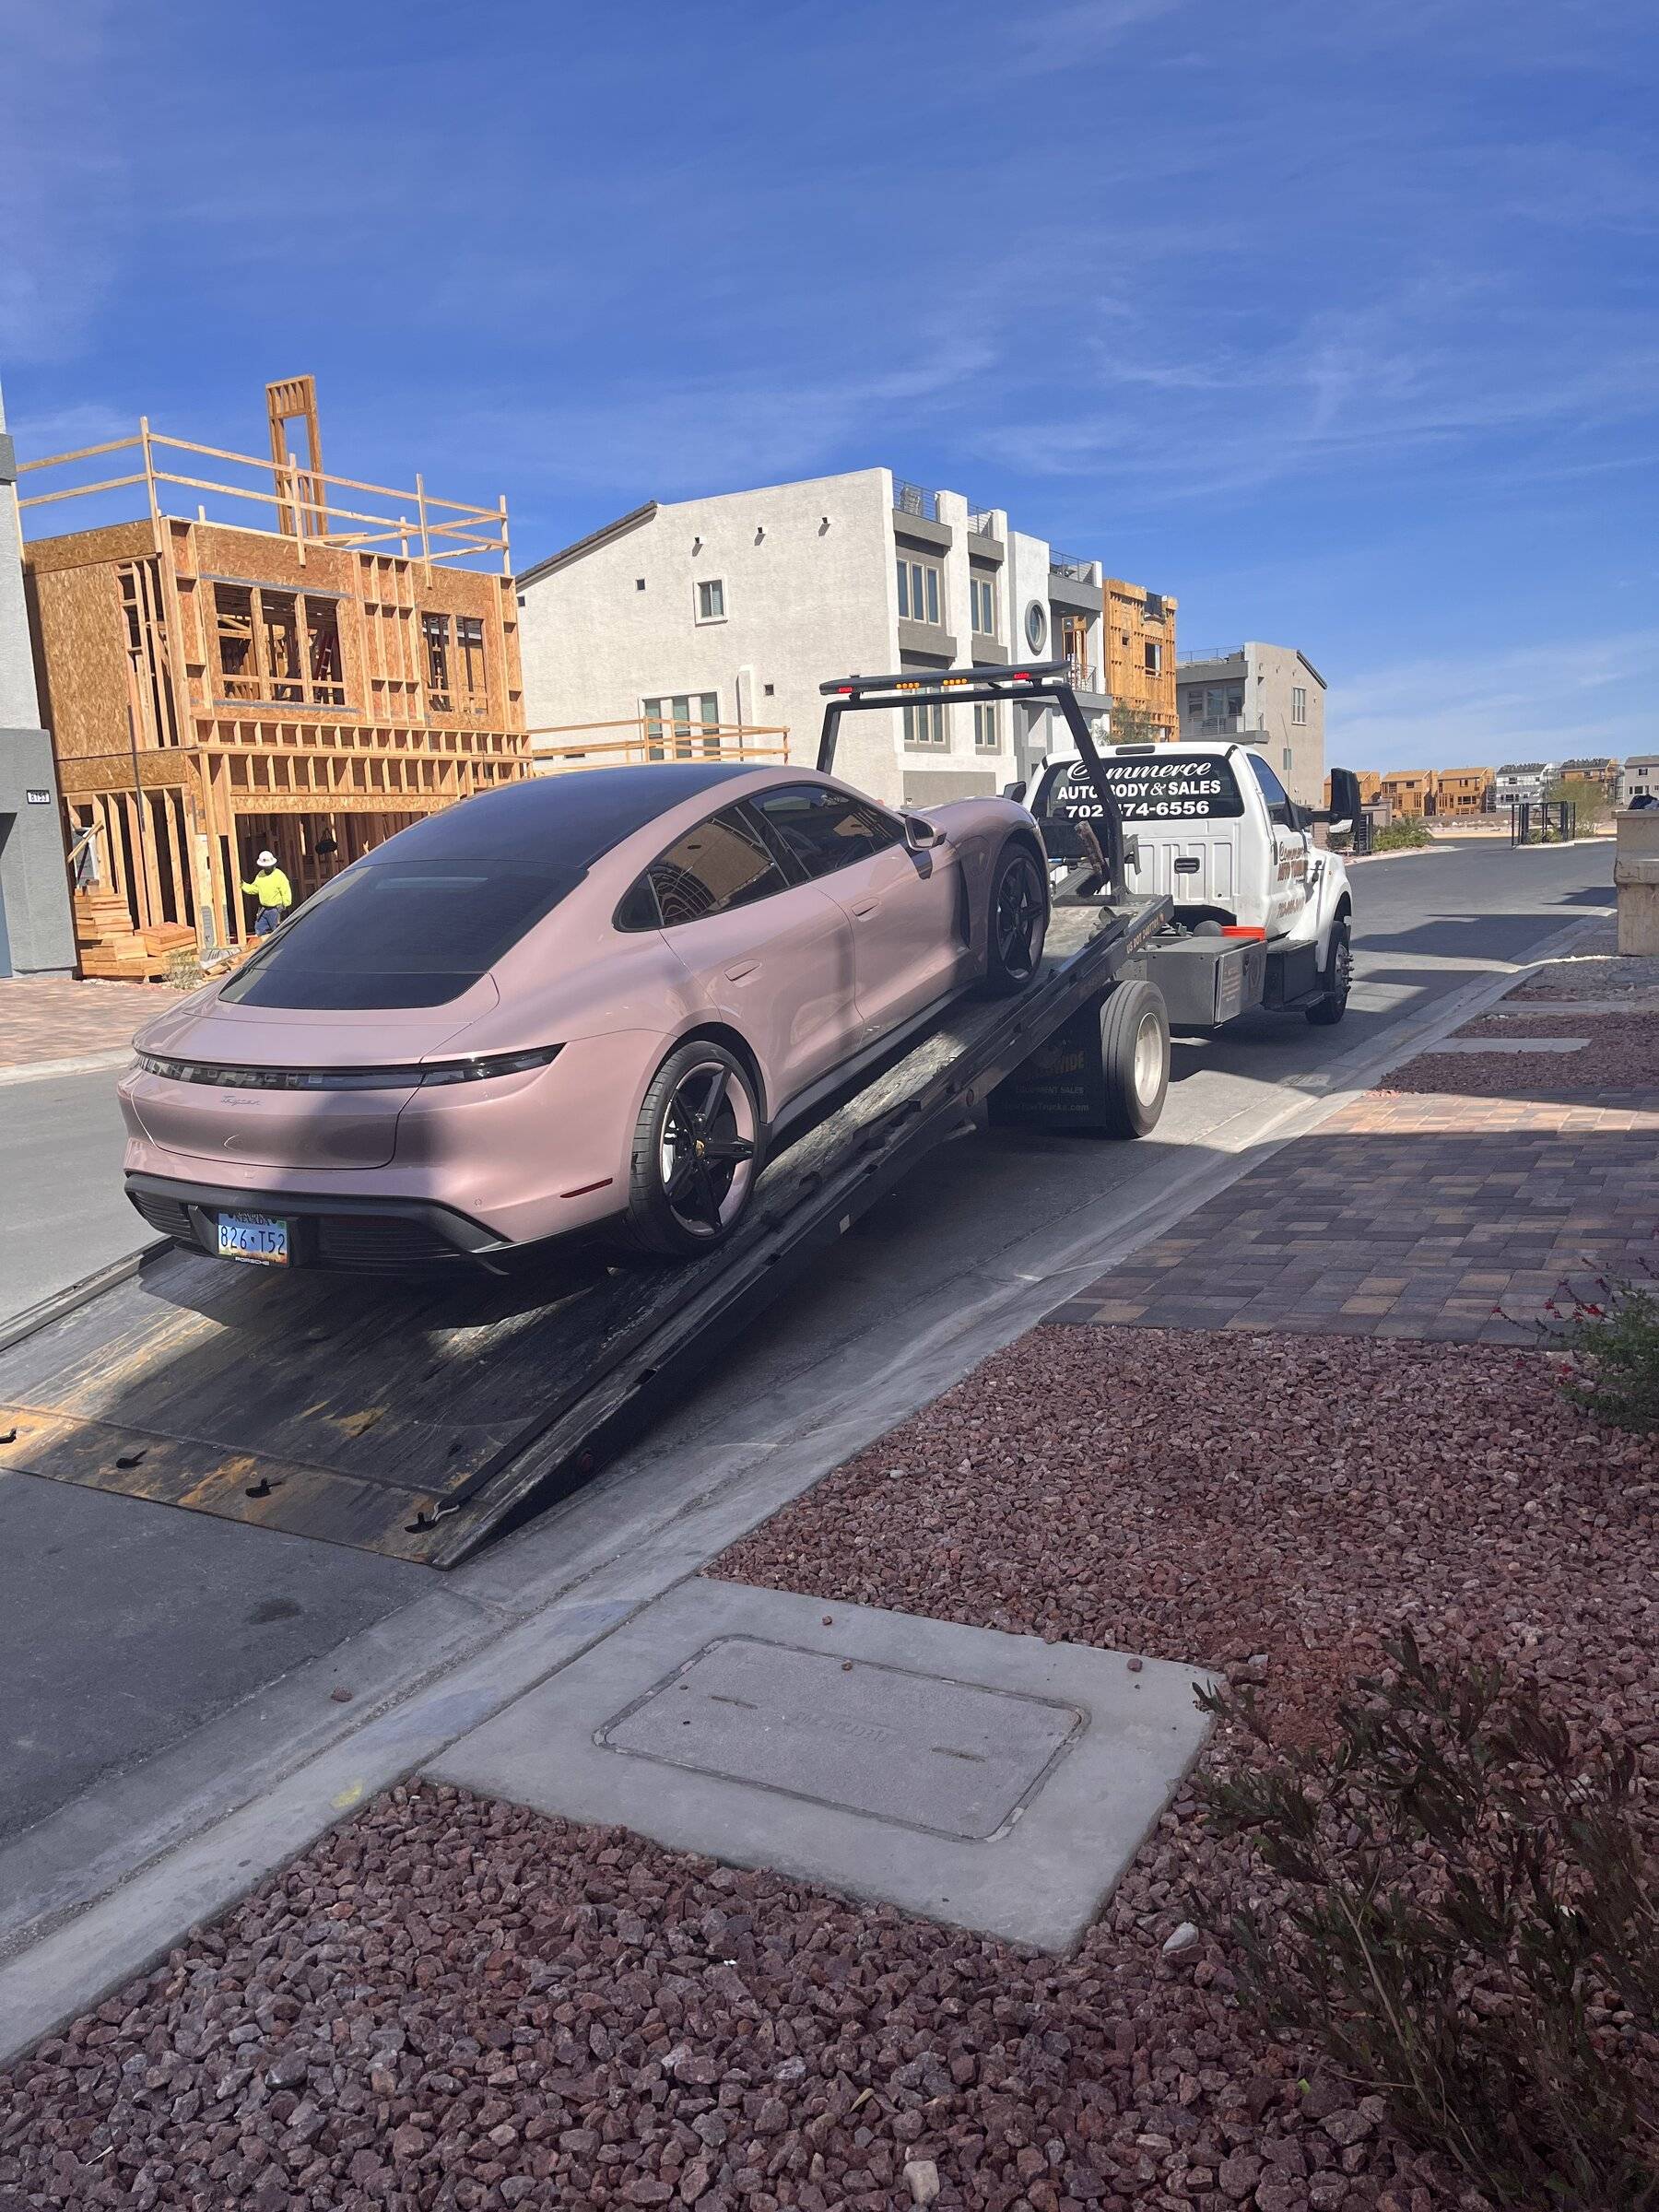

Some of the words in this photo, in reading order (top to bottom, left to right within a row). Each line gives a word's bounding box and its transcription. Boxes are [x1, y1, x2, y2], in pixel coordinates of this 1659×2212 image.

[1066, 759, 1212, 782] Cmmerce
[1149, 782, 1165, 796] &
[1168, 779, 1221, 795] SALES
[1066, 805, 1104, 818] 702
[221, 1226, 247, 1250] 826
[259, 1230, 286, 1255] T52
